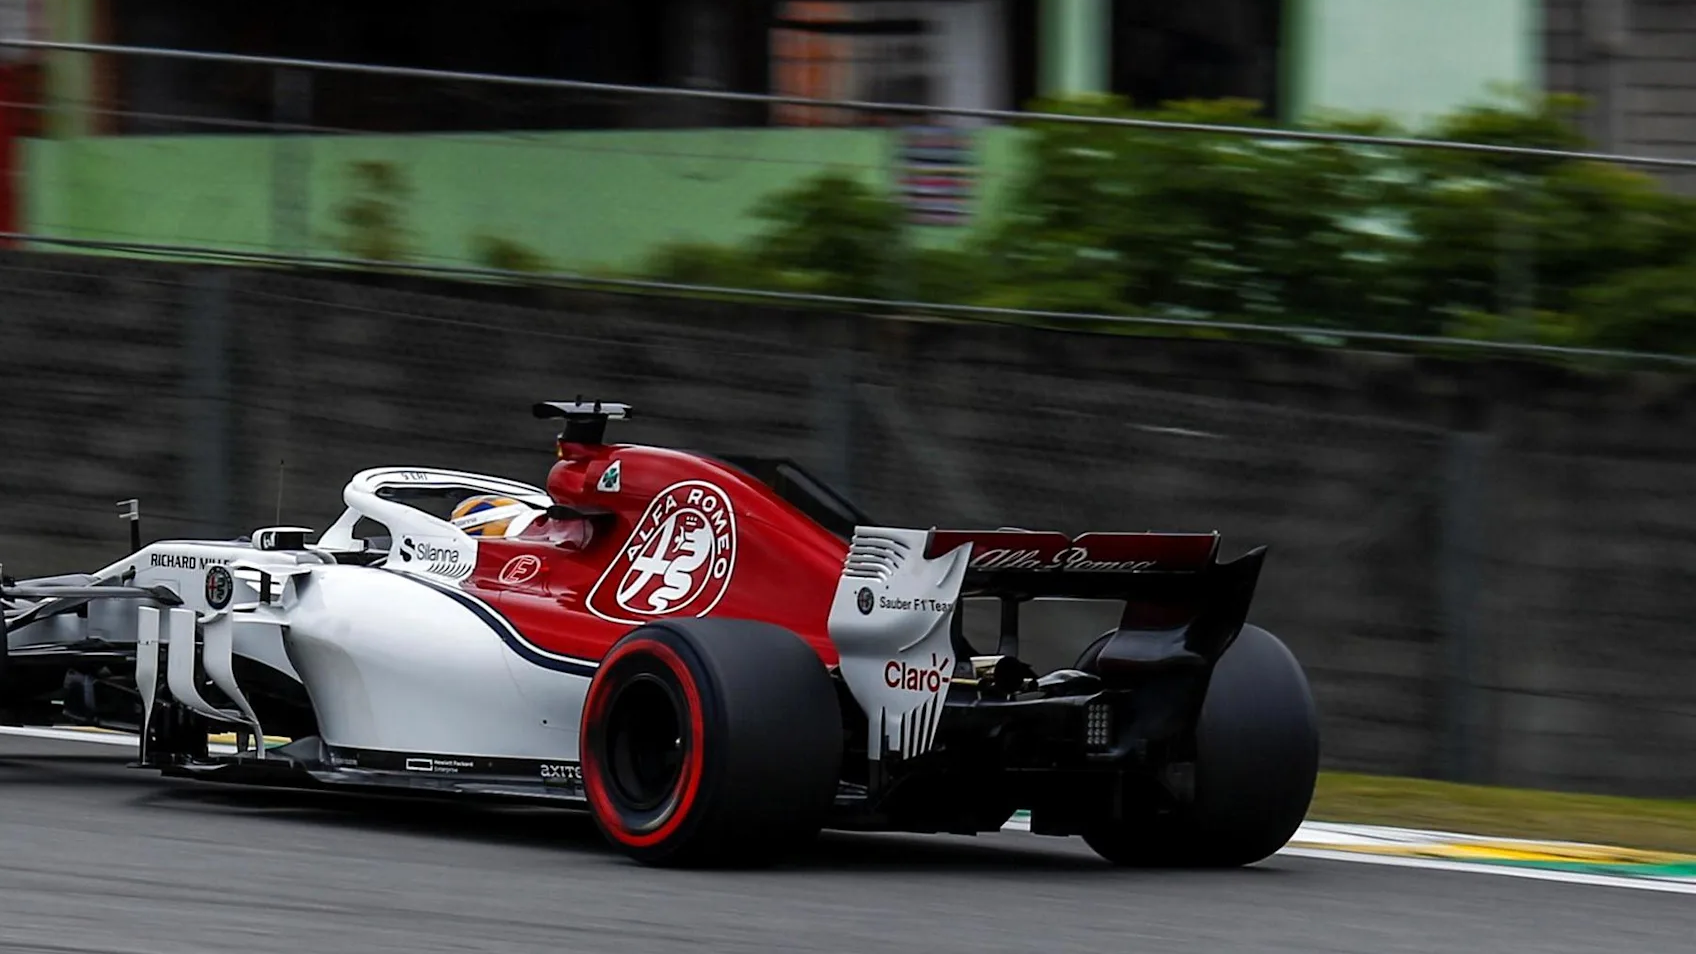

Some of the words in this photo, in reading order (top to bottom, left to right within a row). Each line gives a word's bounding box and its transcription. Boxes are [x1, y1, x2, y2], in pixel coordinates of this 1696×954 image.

[626, 494, 677, 562] ALFA
[687, 488, 730, 579] ROMEO
[150, 554, 196, 569] RICHARD
[417, 543, 459, 563] Silanna
[969, 549, 1041, 568] Alfa
[1044, 547, 1156, 569] Romeo
[879, 596, 911, 610] Sauber
[914, 599, 926, 611] F1
[884, 660, 941, 693] Claro
